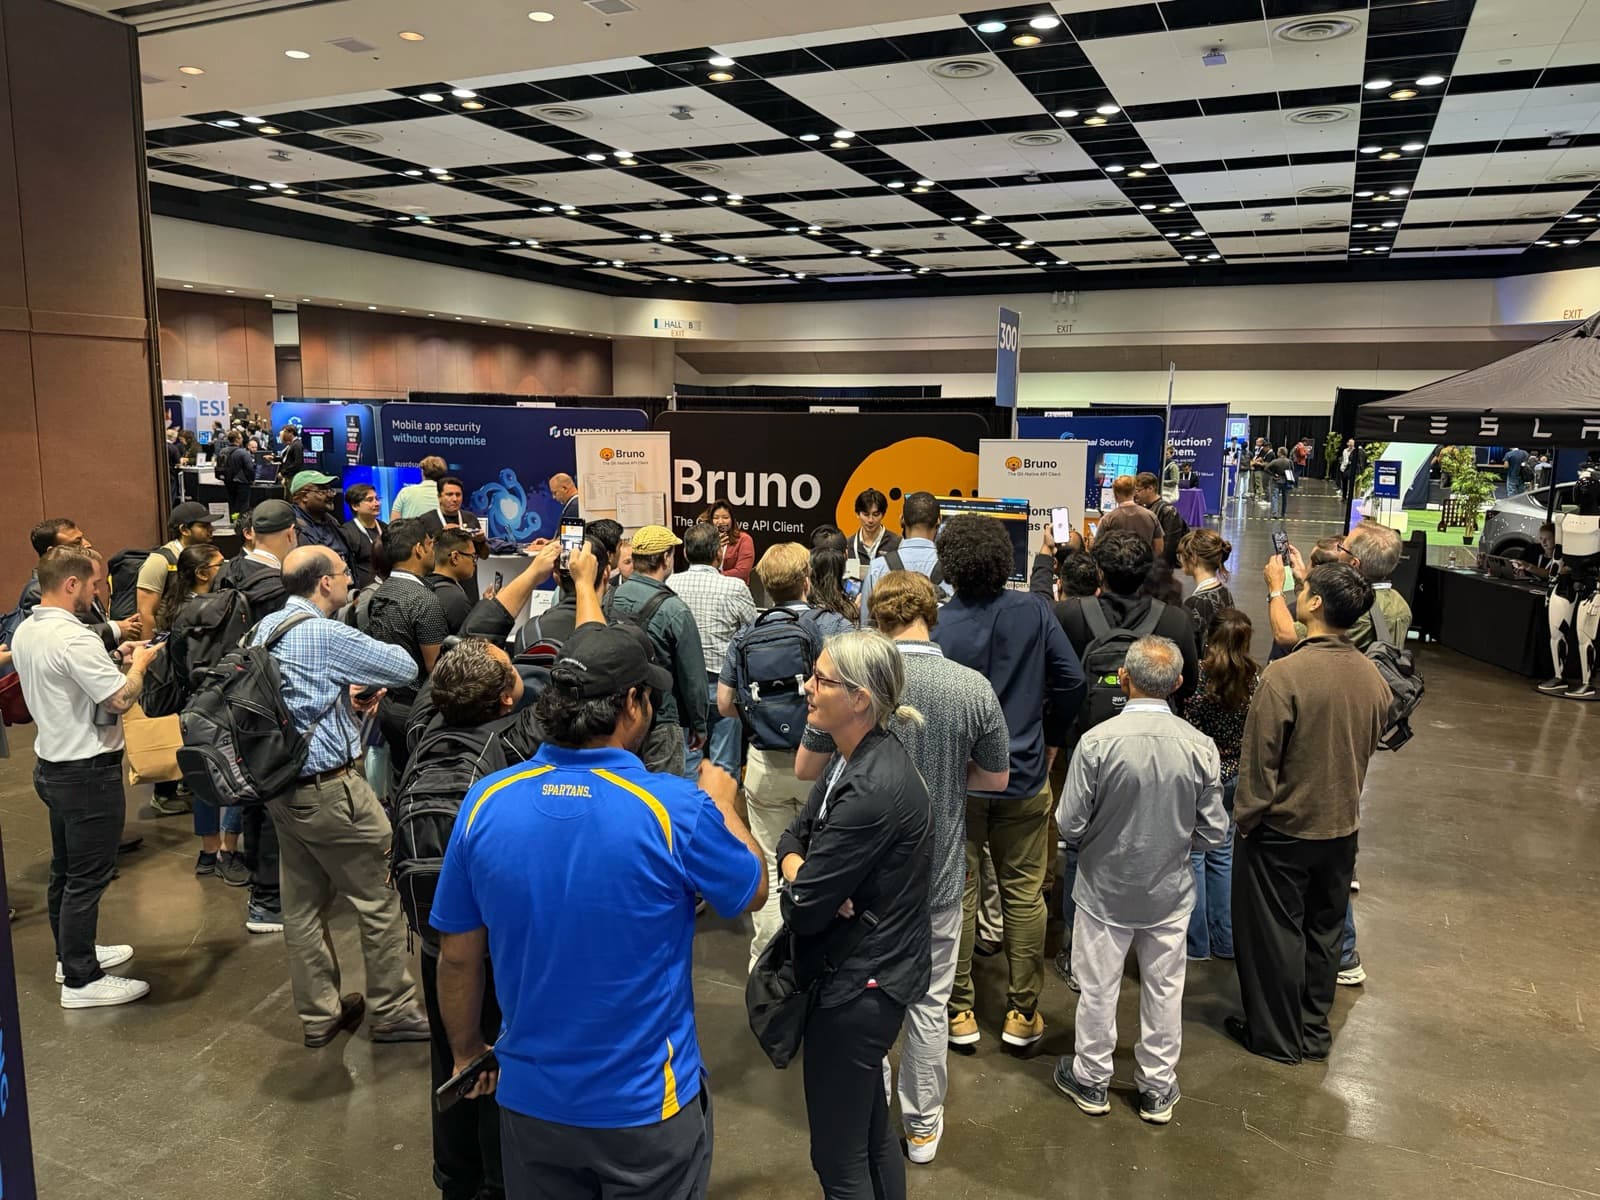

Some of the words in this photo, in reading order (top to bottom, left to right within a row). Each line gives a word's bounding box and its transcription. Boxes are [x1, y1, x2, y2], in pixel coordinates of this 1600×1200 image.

[1563, 308, 1583, 320] EXIT
[664, 320, 682, 329] HALL
[1056, 324, 1072, 333] EXIT
[672, 329, 685, 337] EXIT
[1000, 322, 1018, 352] 300
[391, 420, 422, 430] Mobile
[424, 422, 442, 432] app
[443, 422, 481, 434] security
[1387, 415, 1600, 440] TESLA
[392, 432, 428, 443] without
[429, 435, 487, 447] compromise
[1099, 438, 1134, 448] Security
[1167, 437, 1213, 447] duction?
[615, 449, 645, 458] Bruno
[1172, 447, 1197, 457] hem.
[1024, 458, 1057, 469] Bruno
[674, 459, 821, 509] Bruno
[674, 515, 693, 527] The
[752, 520, 769, 531] API
[772, 520, 804, 533] Client
